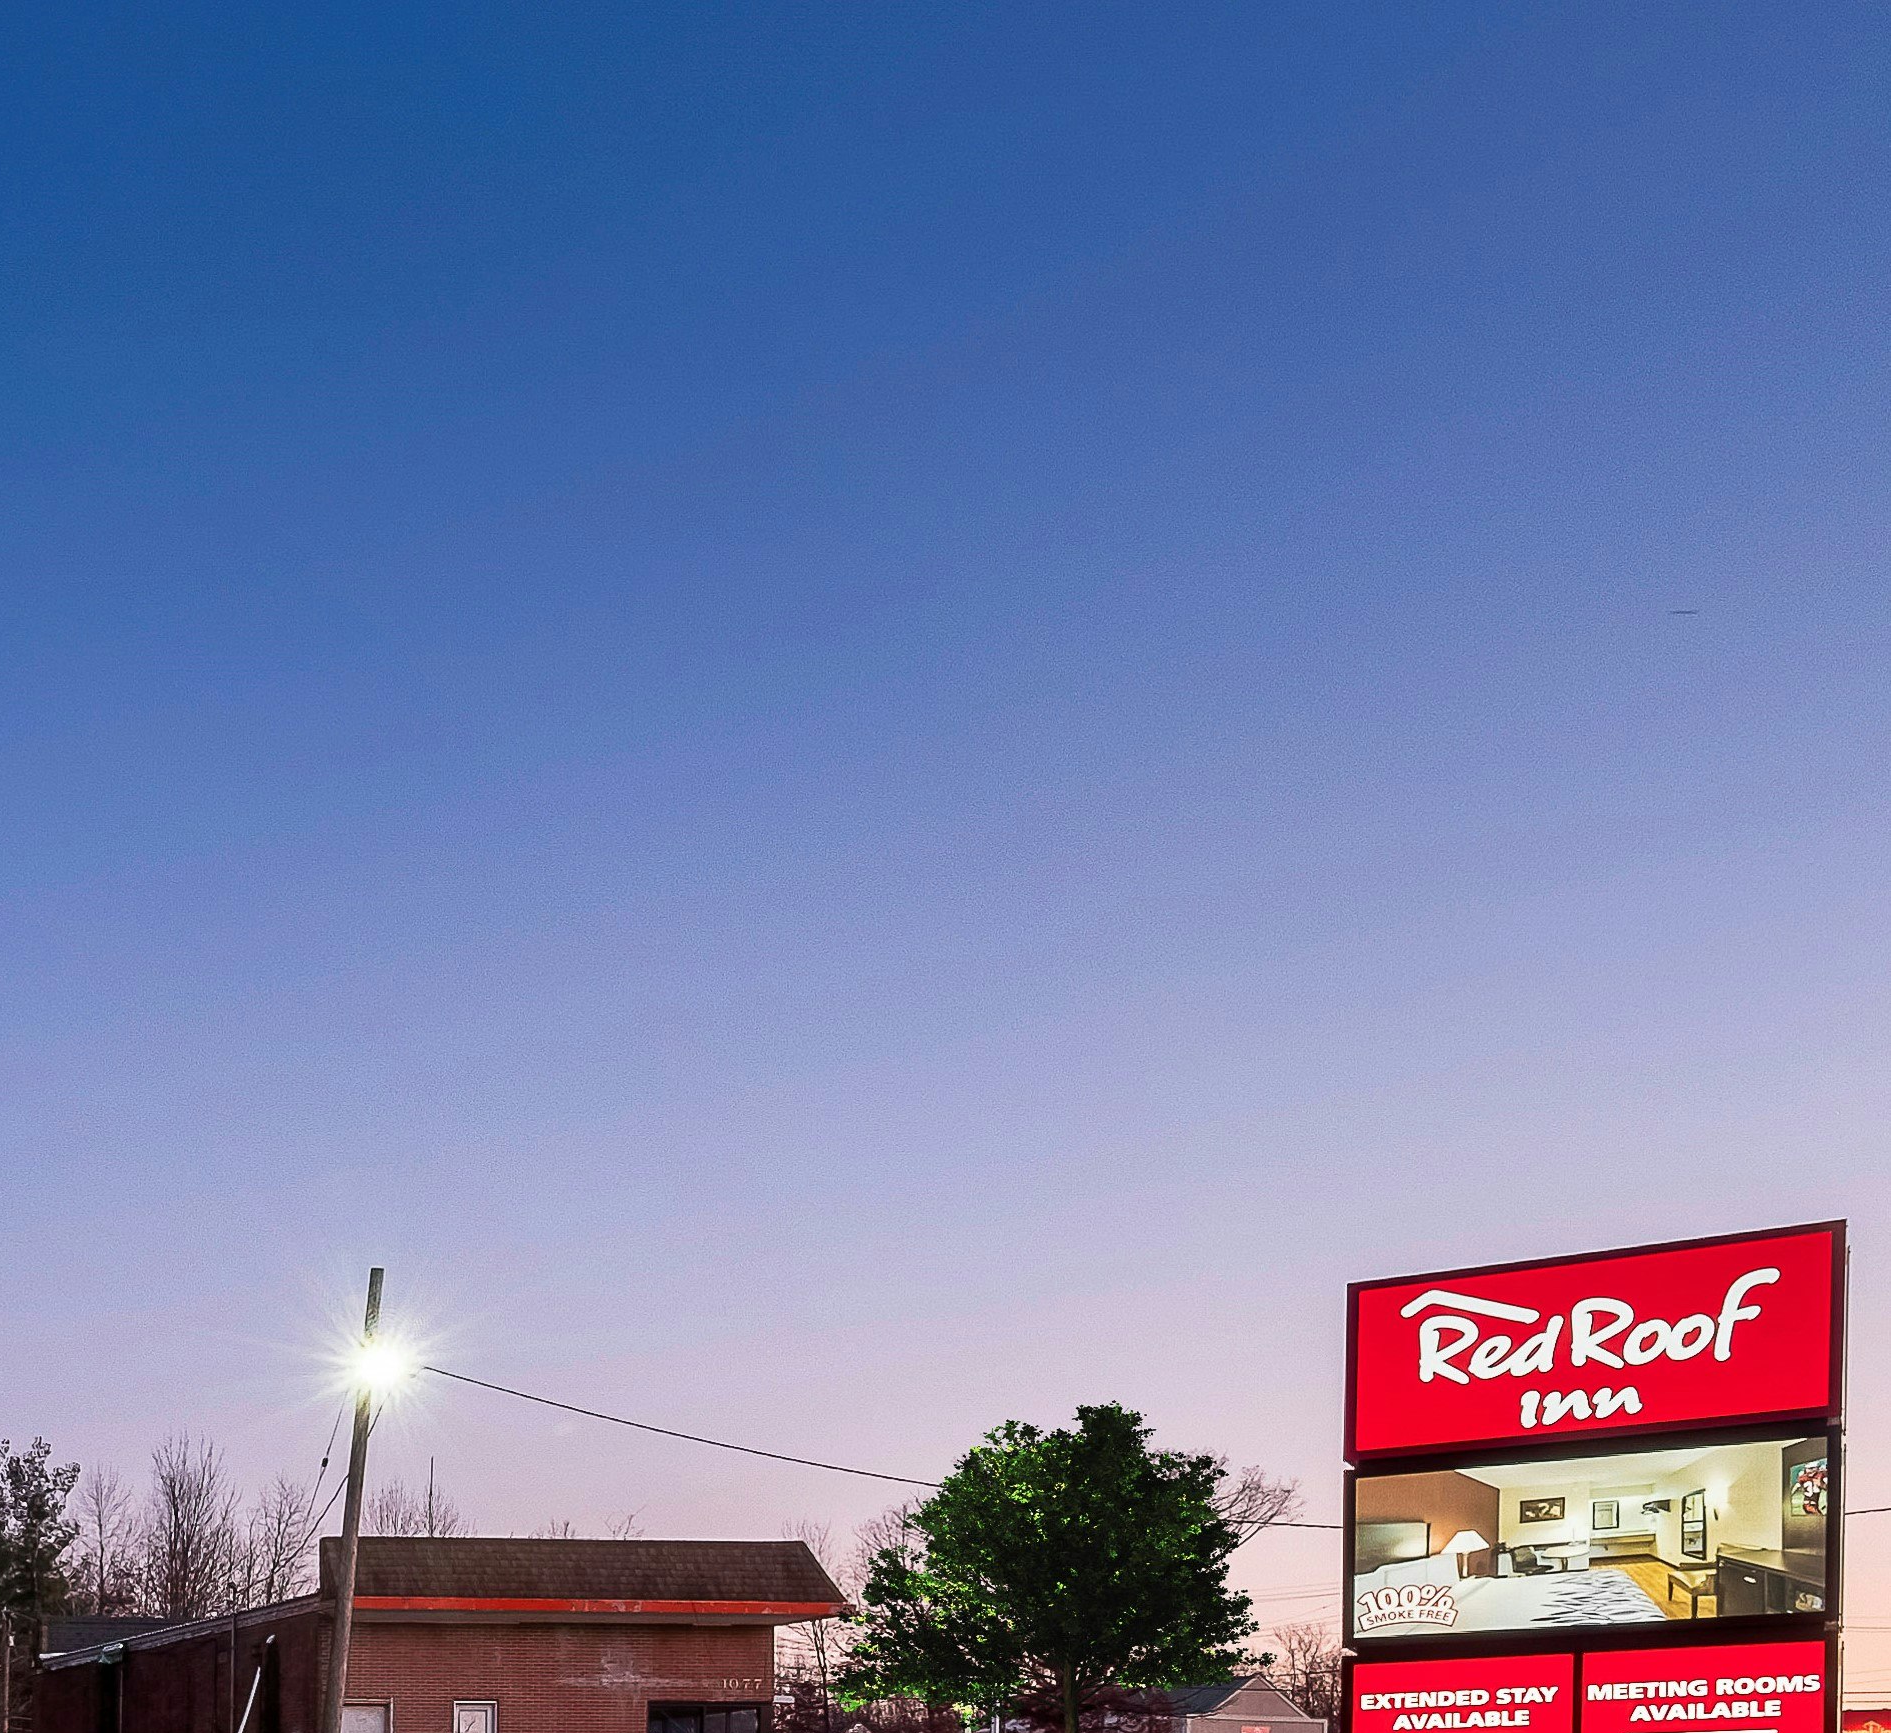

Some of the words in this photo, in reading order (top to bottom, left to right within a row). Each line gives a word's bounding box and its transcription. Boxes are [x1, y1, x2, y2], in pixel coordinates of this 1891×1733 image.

[1357, 1584, 1455, 1613] 100%
[1366, 1609, 1415, 1626] SMOKE
[1418, 1609, 1452, 1622] FREE
[722, 1678, 763, 1690] 1077
[1587, 1680, 1709, 1701] MEETING
[1715, 1674, 1821, 1696] ROOMS
[1360, 1690, 1490, 1711] EXTENDED
[1495, 1686, 1559, 1705] STAY
[1392, 1709, 1530, 1731] AVAILABLE
[1629, 1700, 1782, 1722] AVAILABLE
